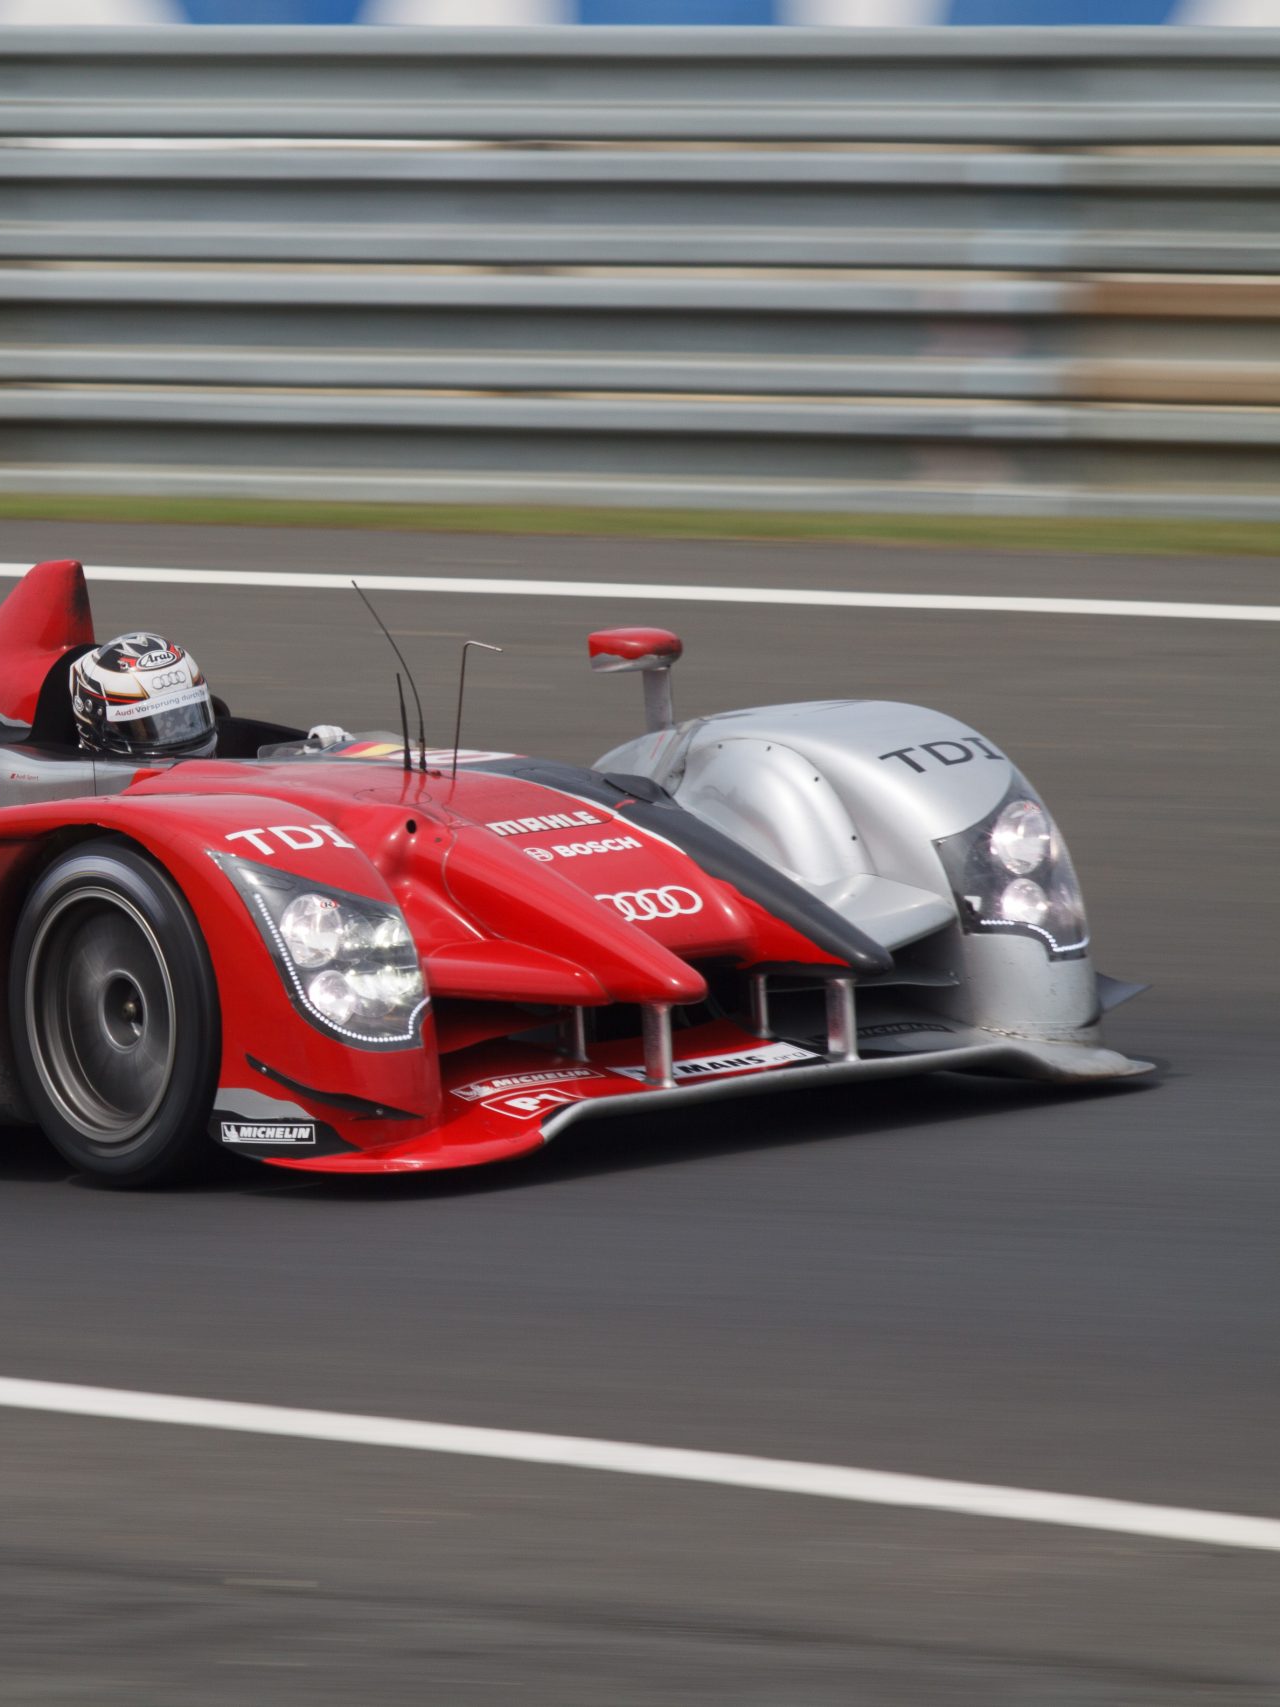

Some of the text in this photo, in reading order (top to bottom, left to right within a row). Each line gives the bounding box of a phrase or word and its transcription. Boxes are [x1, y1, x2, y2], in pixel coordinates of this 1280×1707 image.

[144, 652, 172, 667] Arai
[115, 709, 135, 717] Audi
[135, 697, 180, 714] Vorsprung
[878, 737, 1006, 774] TDI
[485, 811, 602, 837] MAHLE
[224, 824, 356, 856] TDI
[551, 836, 643, 858] BOSCH
[677, 1055, 766, 1074] MANS
[491, 1069, 591, 1088] MICHELIN
[504, 1093, 571, 1111] P1
[240, 1126, 311, 1140] MICHELIN
